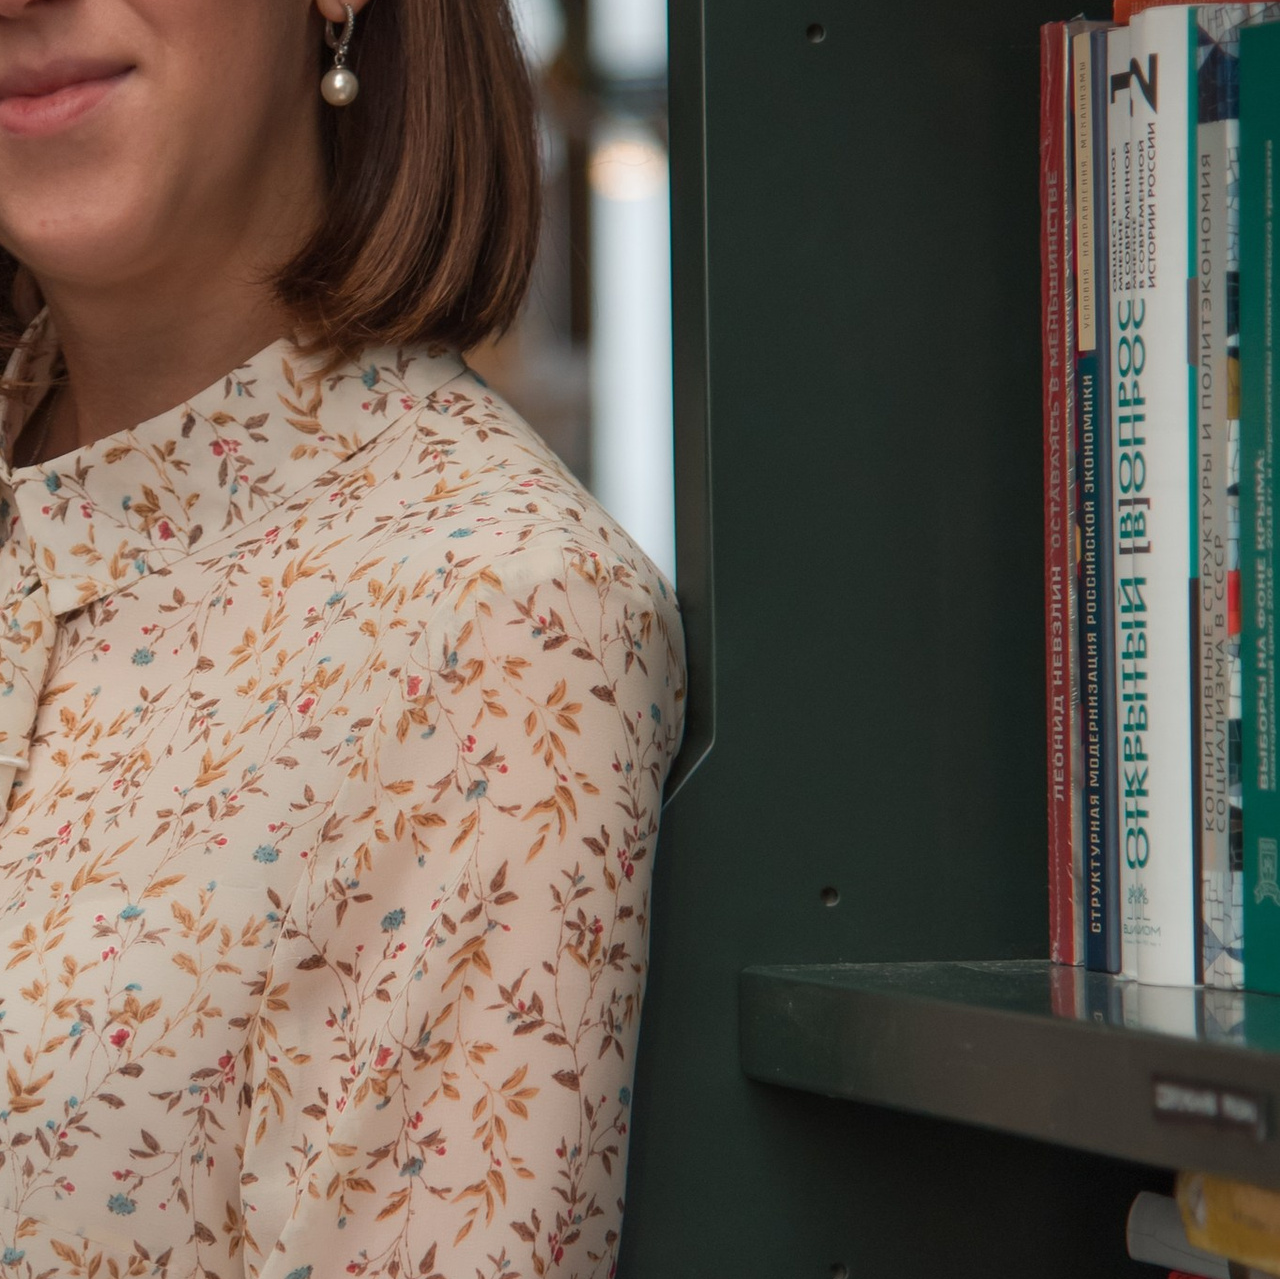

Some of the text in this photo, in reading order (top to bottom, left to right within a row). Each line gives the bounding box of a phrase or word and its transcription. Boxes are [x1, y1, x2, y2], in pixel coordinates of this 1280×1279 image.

[1123, 141, 1131, 278] СОВРЕМЕННОЙ
[1130, 53, 1158, 116] 2
[1137, 139, 1145, 275] СОВРЕМЕННОЙ
[1147, 121, 1156, 288] ИСТОРИИ РОССИИ
[1045, 169, 1065, 801] ЛЕОНИД НЕВЗЛИН ОСТАВАЯСЬ В МЕНЬШИНСТВЕ
[1200, 153, 1214, 831] КОГНИТИВНЫЕ СТРУКТУРЫ И ПОЛИТЭКОНОМИЯ
[1254, 449, 1269, 790] ВЫБОРЫ НА ФОНЕ КРЫМА:
[1082, 373, 1102, 933] СТРУКТУРНАЯ МОДЕРНИЗАЦИЯ РОССИЙСКОЙ ЭКОНОМИКИ
[1214, 534, 1227, 832] СОЦИАЛИЗМА В СССР
